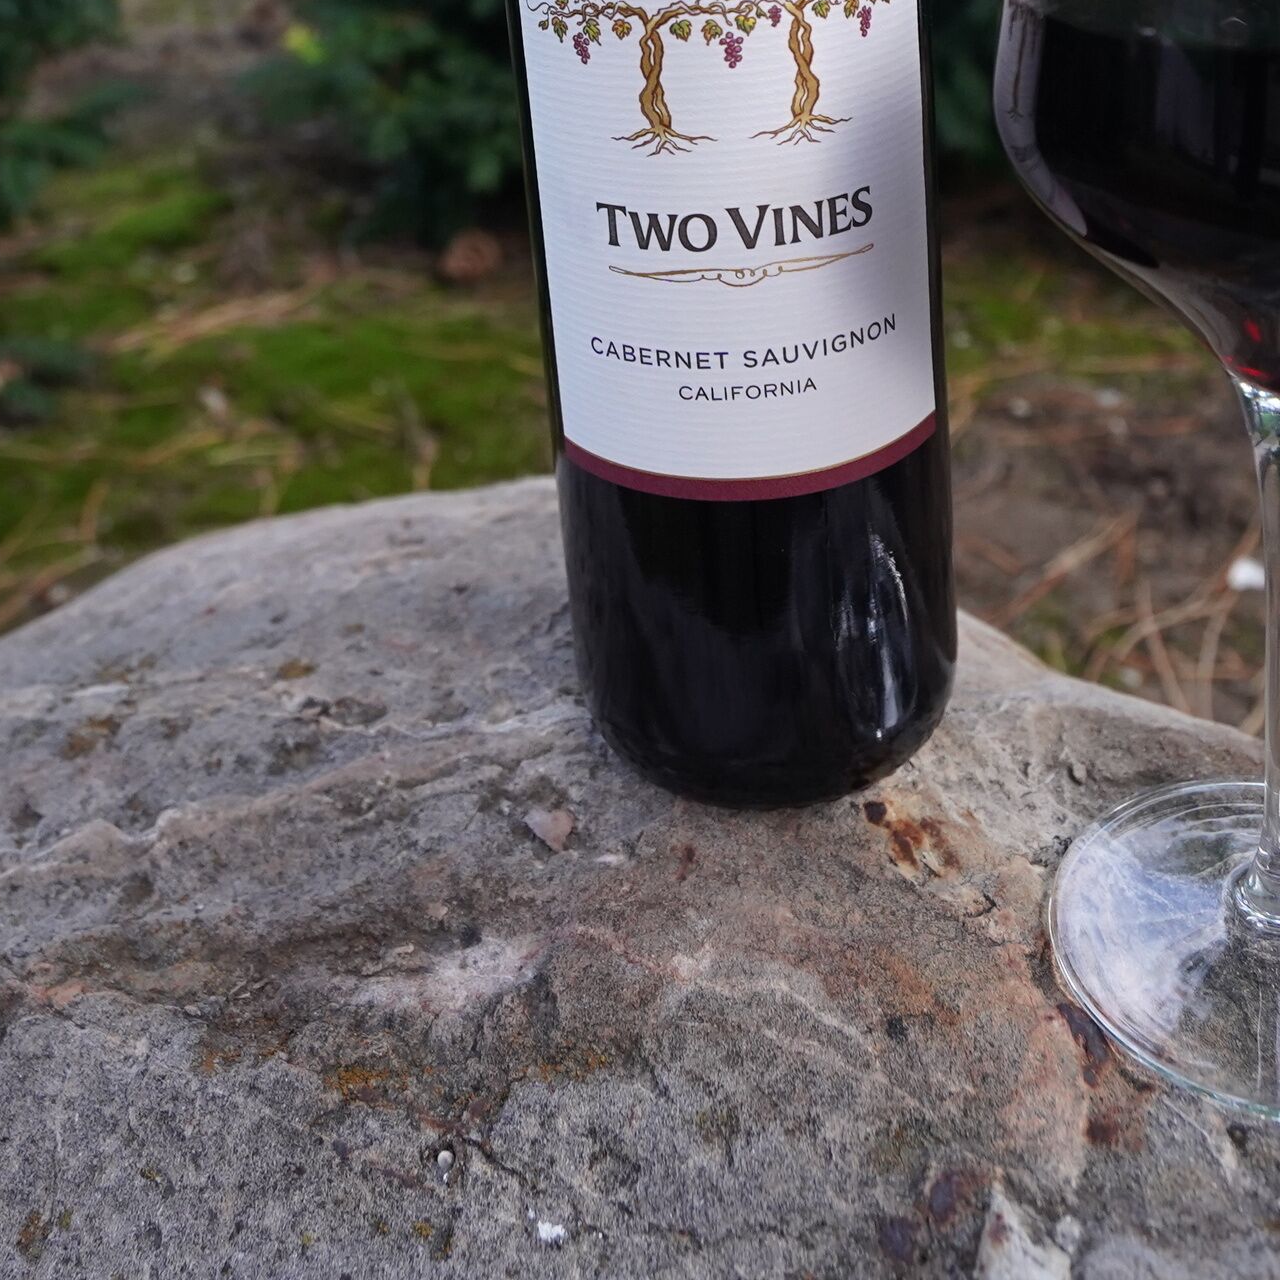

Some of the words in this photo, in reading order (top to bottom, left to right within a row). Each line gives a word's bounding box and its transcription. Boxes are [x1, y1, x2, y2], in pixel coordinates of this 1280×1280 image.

[596, 201, 718, 253] TWO
[724, 185, 873, 250] VINES
[590, 336, 729, 370] CABERNET
[743, 313, 896, 368] SAUVIGNON
[678, 377, 817, 401] CALIFORNIA
